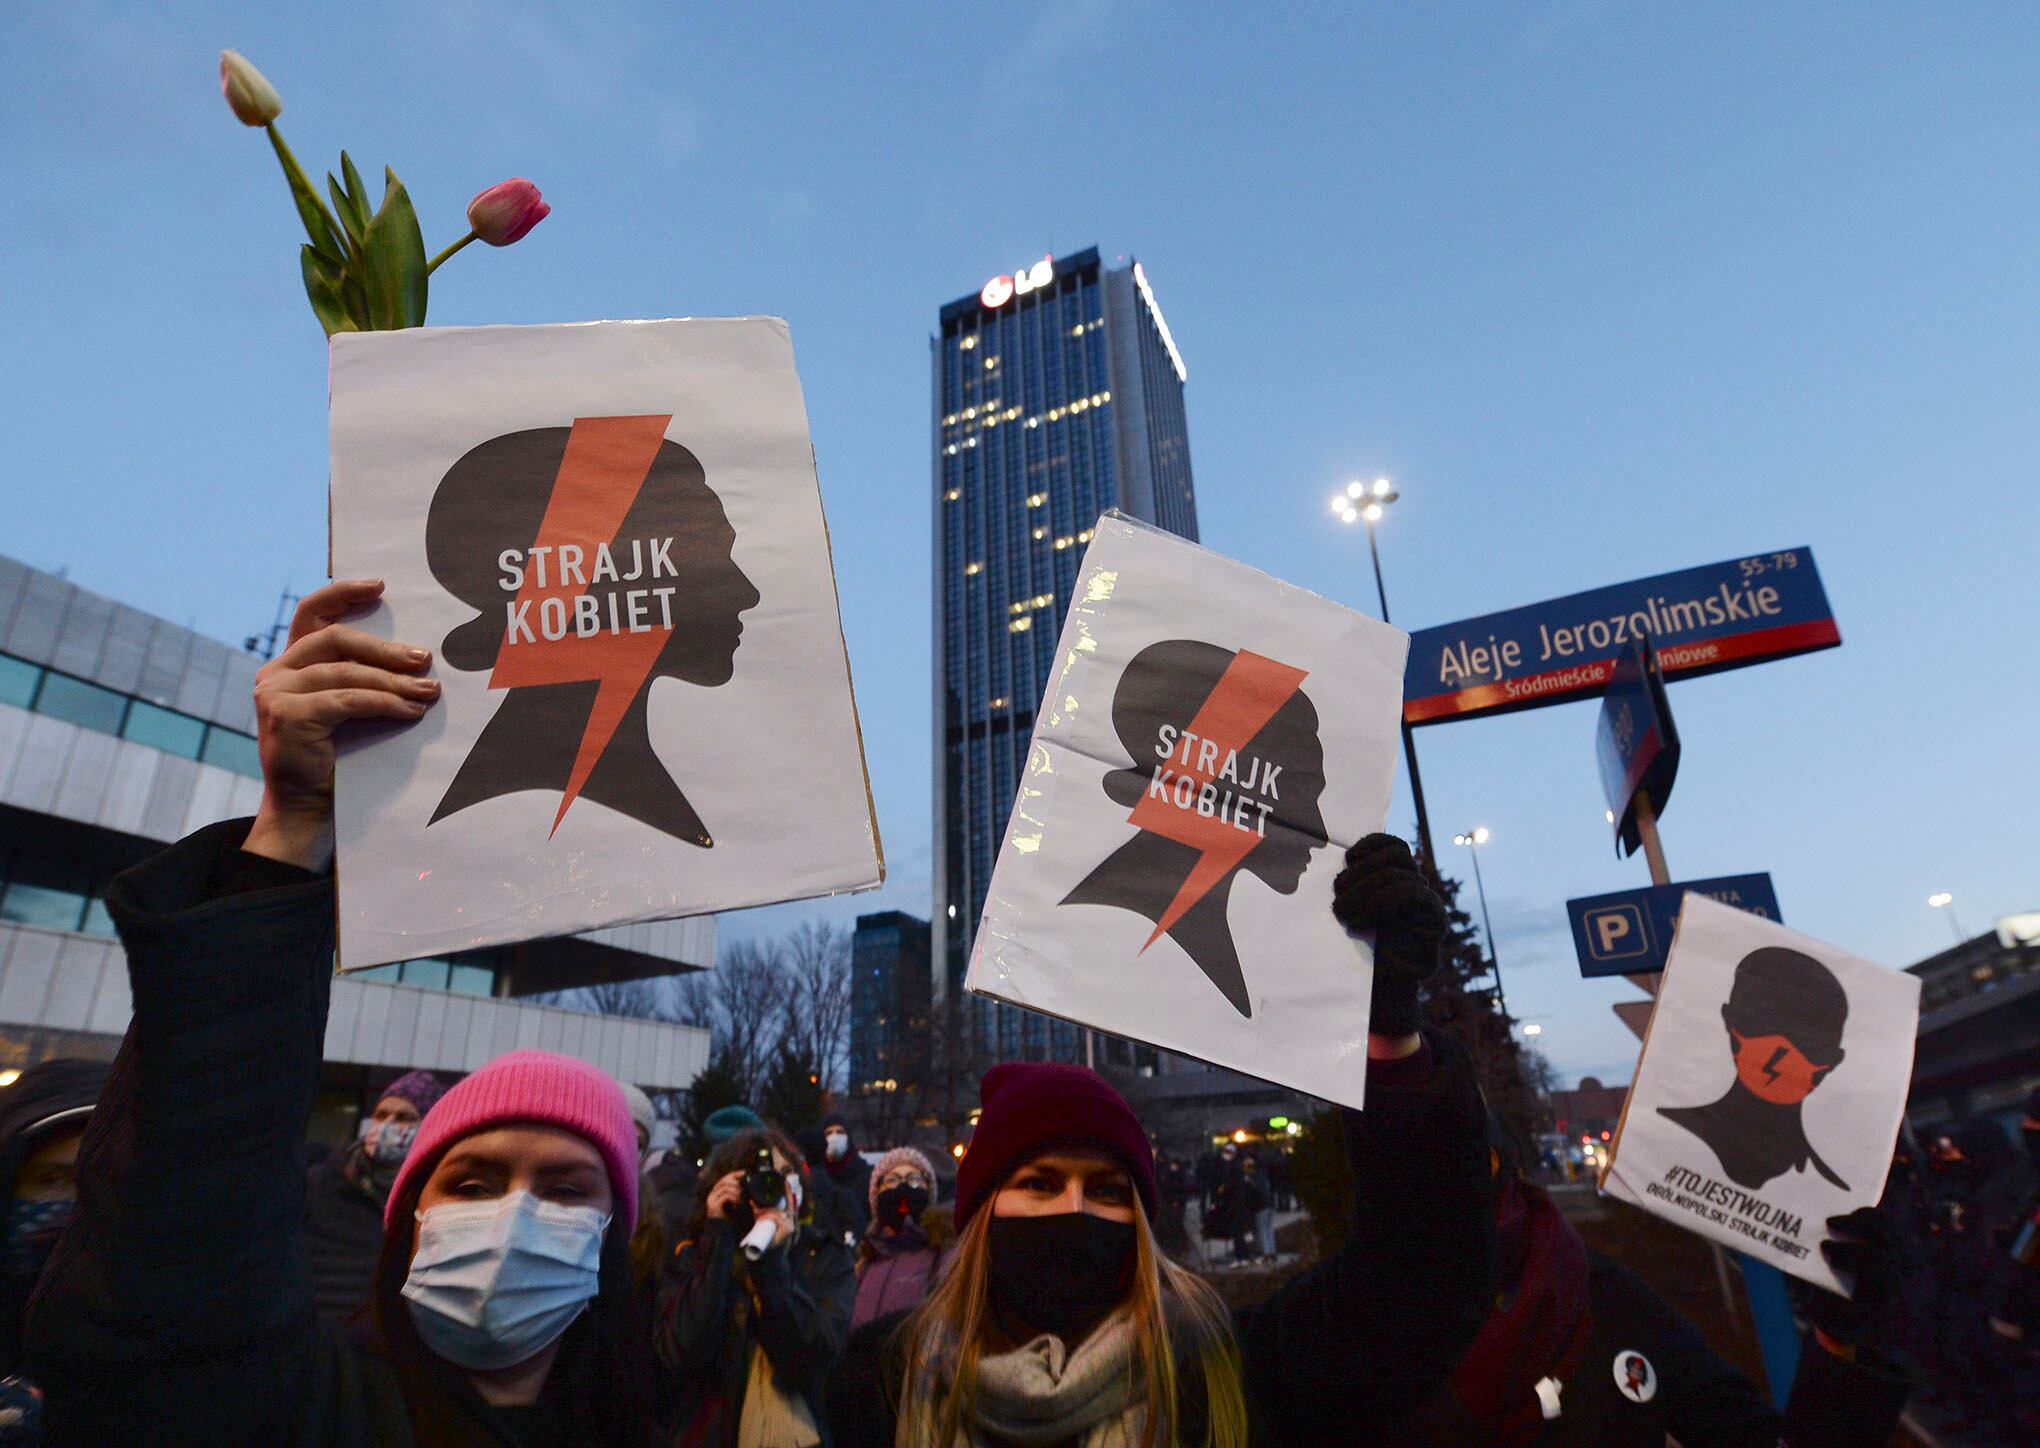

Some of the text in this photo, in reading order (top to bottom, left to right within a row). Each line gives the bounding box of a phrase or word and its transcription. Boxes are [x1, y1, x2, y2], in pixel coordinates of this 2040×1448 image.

[498, 537, 679, 591] STRAJK
[1739, 552, 1798, 577] 55-79
[506, 587, 677, 645] KOBIET
[1440, 579, 1782, 683] Aleje Jerozolimskie
[1505, 666, 1605, 698] Śródmieście
[1155, 724, 1283, 800] STRAJK
[1150, 765, 1274, 838] KOBIET
[1596, 913, 1630, 952] P
[1664, 1165, 1803, 1238] #TOJESTWOJNA
[1728, 1217, 1769, 1247] STRAJK
[1770, 1237, 1810, 1260] KOBIET
